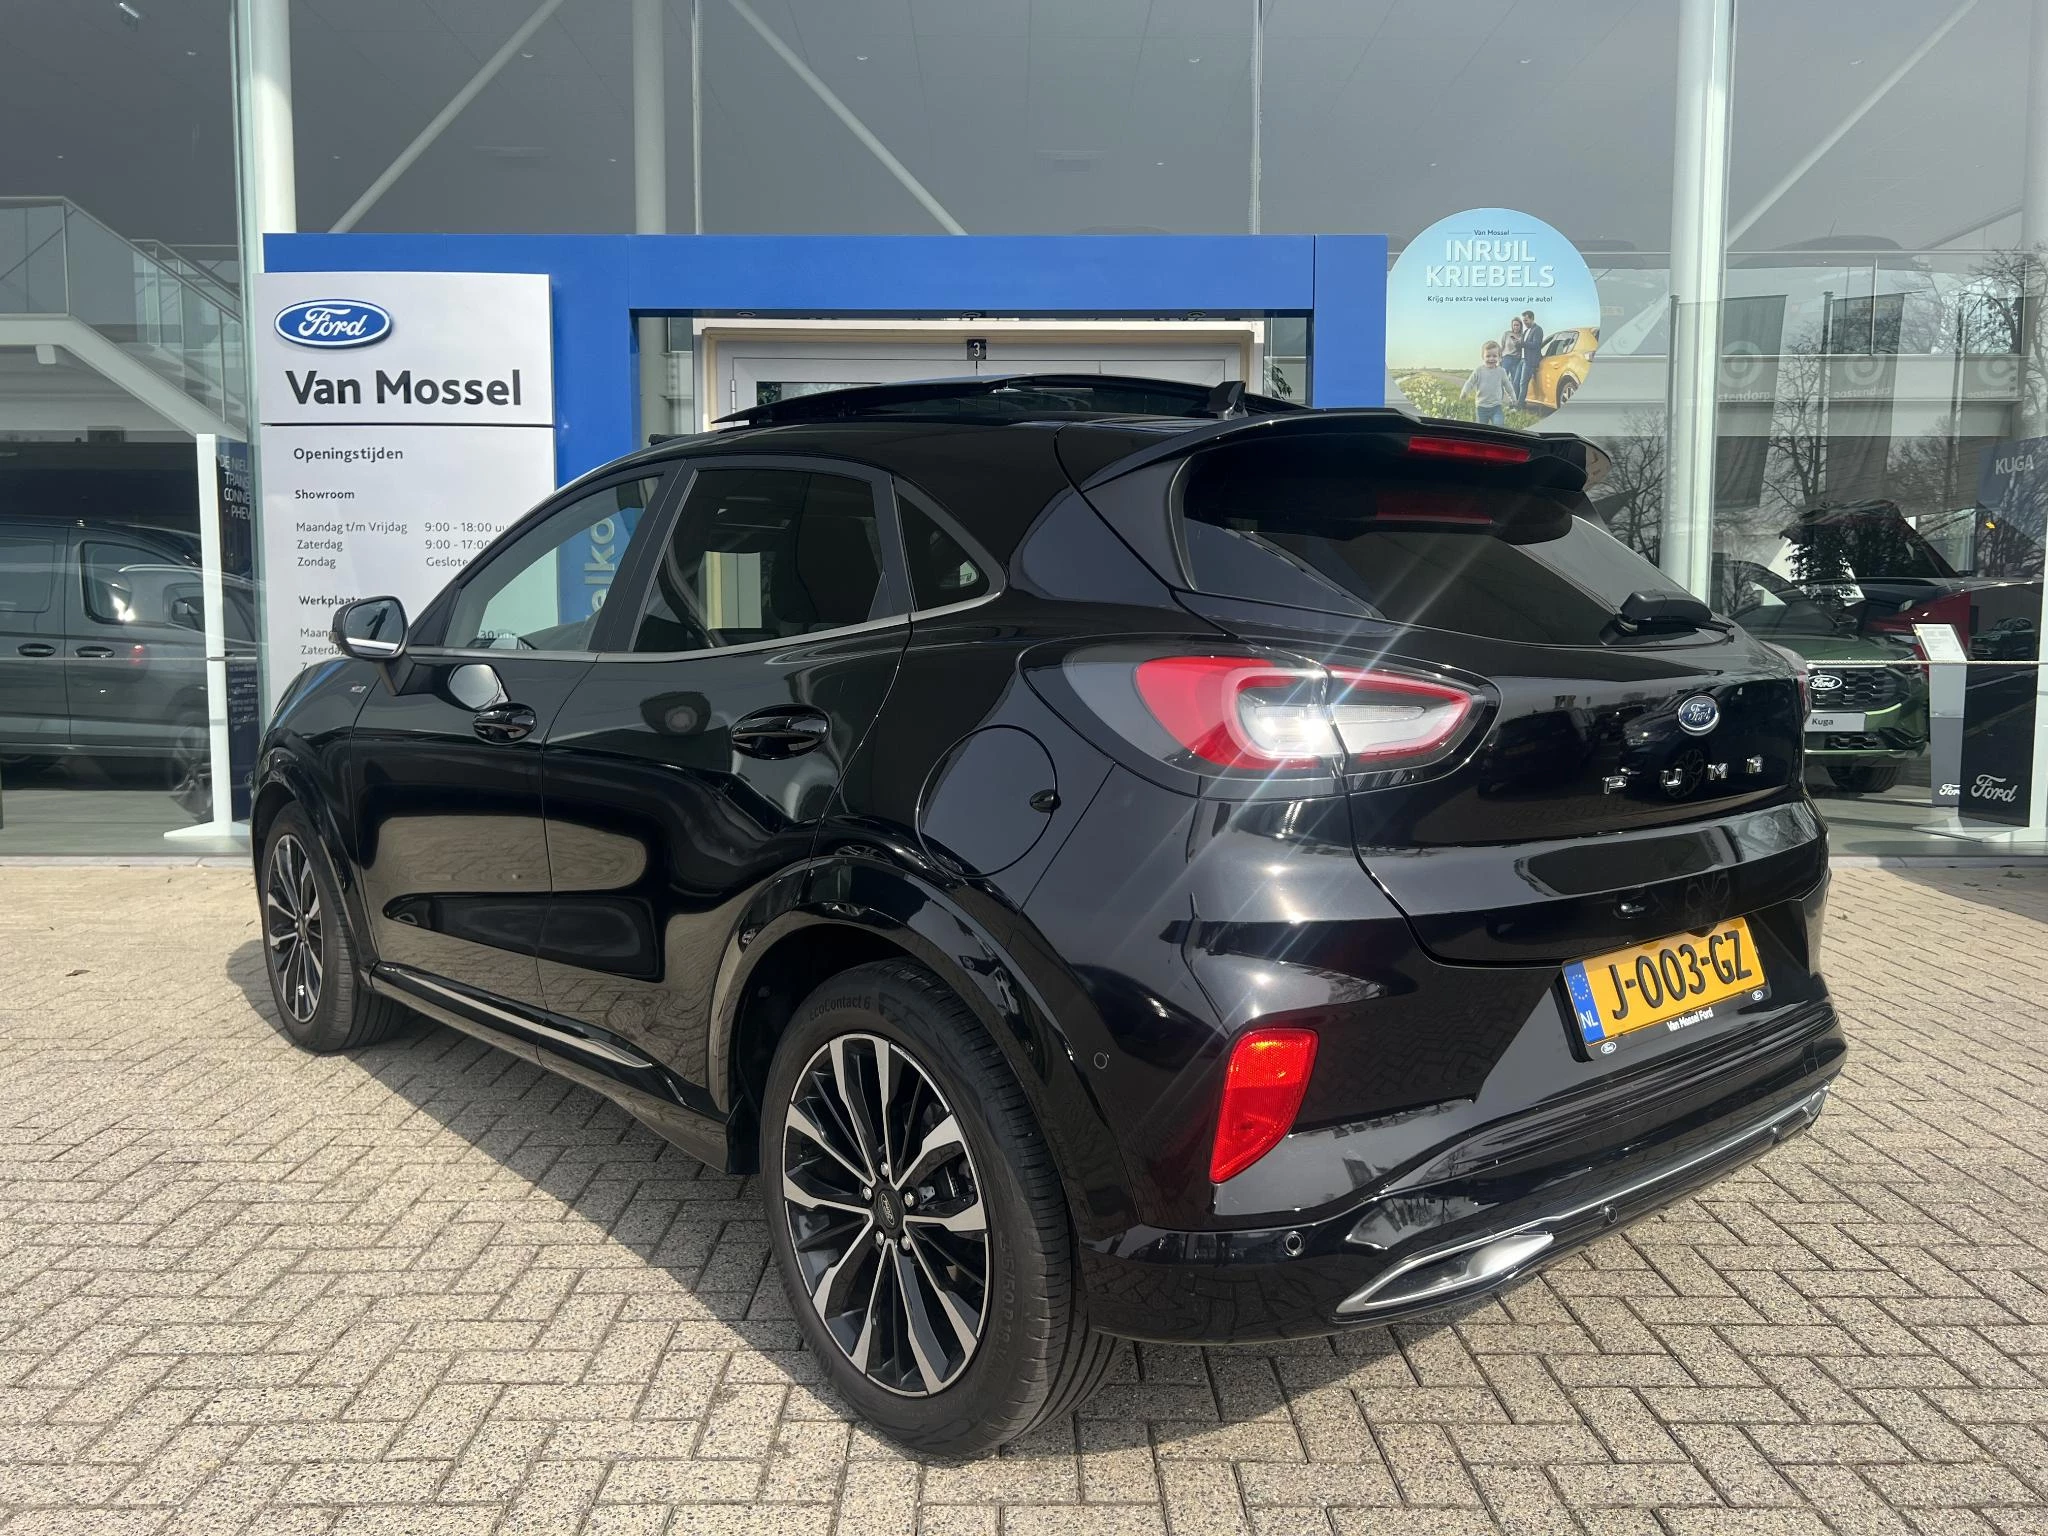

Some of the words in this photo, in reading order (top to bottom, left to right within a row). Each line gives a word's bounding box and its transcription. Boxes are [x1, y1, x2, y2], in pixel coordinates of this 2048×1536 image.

[1446, 239, 1537, 263] INRUIL
[1425, 265, 1556, 288] KRIEBELS
[1427, 295, 1444, 303] Krijg
[1490, 295, 1509, 303] terug
[1526, 296, 1534, 304] je
[298, 308, 366, 337] Ford
[973, 341, 981, 357] 3
[285, 369, 361, 405] Van
[375, 368, 521, 406] Mossel
[293, 447, 404, 463] Openingstijden
[1995, 454, 2035, 475] KUGA
[224, 487, 251, 504] CONNE
[294, 489, 355, 500] Showroom
[296, 521, 344, 535] Maandag
[345, 521, 366, 533] t/m
[368, 521, 408, 535] Vrijdag
[424, 522, 450, 532] 9:00
[460, 522, 492, 533] 18:00
[297, 539, 343, 552] Zaterdag
[425, 539, 450, 550] 9:00
[297, 556, 337, 570] Zondag
[426, 556, 470, 568] Geslote
[584, 517, 615, 622] elko
[1811, 677, 1836, 688] Ford
[1688, 702, 1711, 722] Ford
[1811, 718, 1834, 727] Kuga
[1602, 754, 1764, 795] PUMA
[1938, 783, 1961, 796] For
[1970, 774, 2018, 803] Ford
[1608, 929, 1753, 1021] J-003-GZ
[863, 996, 872, 1011] 6
[1579, 1012, 1599, 1030] NL
[1667, 1021, 1680, 1032] Van
[1678, 1012, 1701, 1028] Mossel
[1699, 1006, 1715, 1021] Ford
